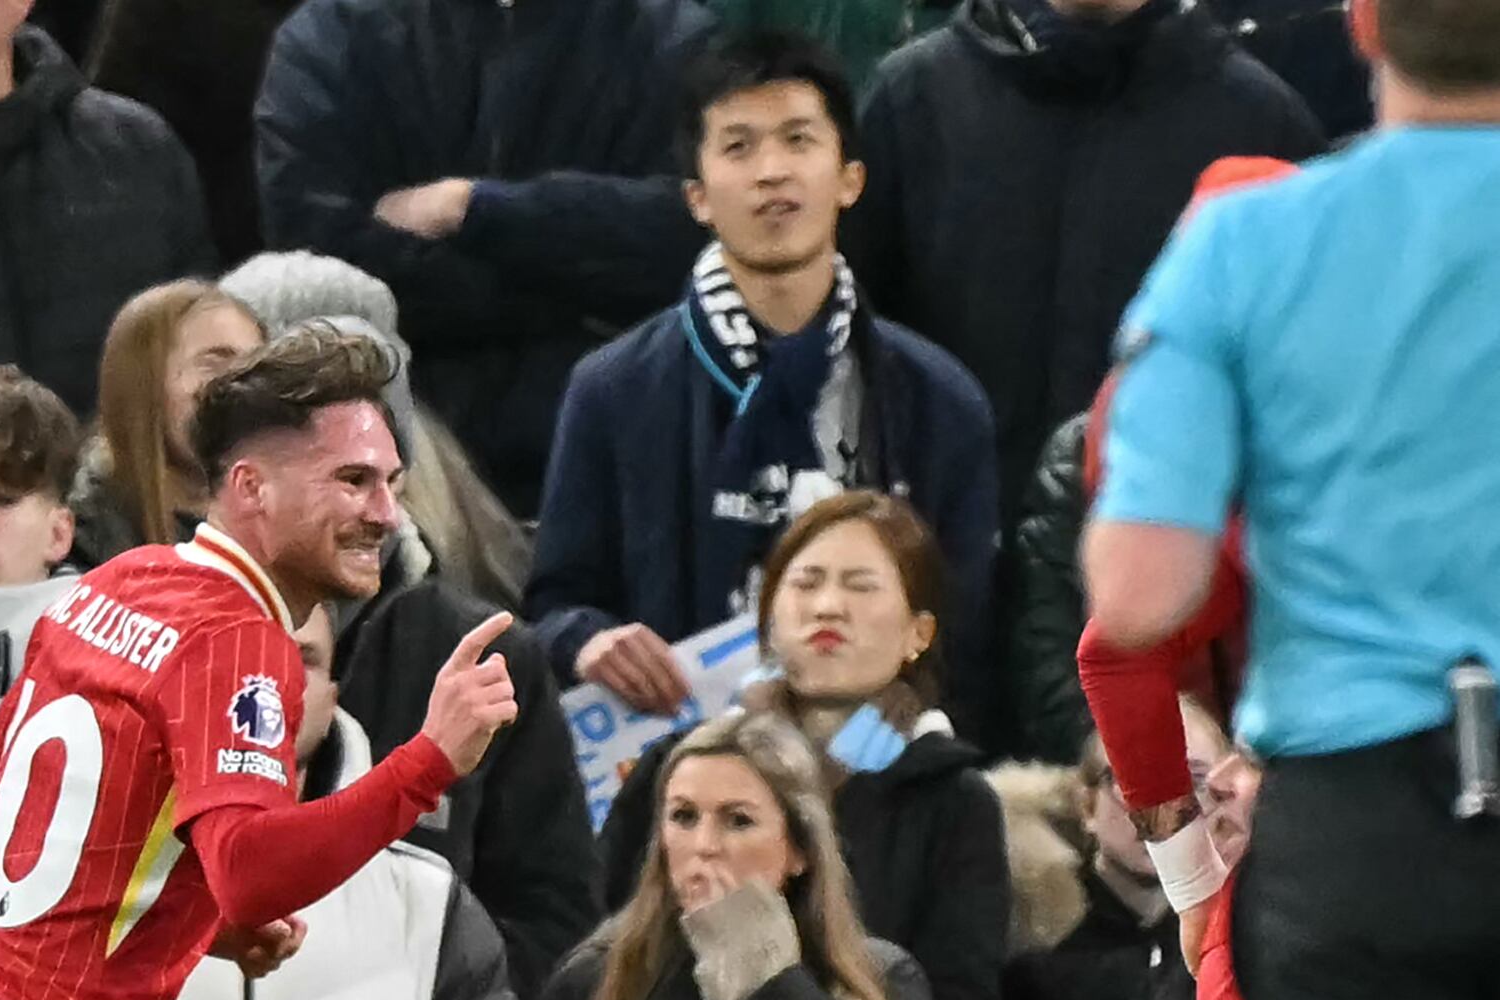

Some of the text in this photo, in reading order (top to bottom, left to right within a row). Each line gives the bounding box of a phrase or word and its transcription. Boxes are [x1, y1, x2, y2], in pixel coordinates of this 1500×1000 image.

[47, 582, 180, 673] AC ALLISTER
[217, 748, 283, 774] No room
